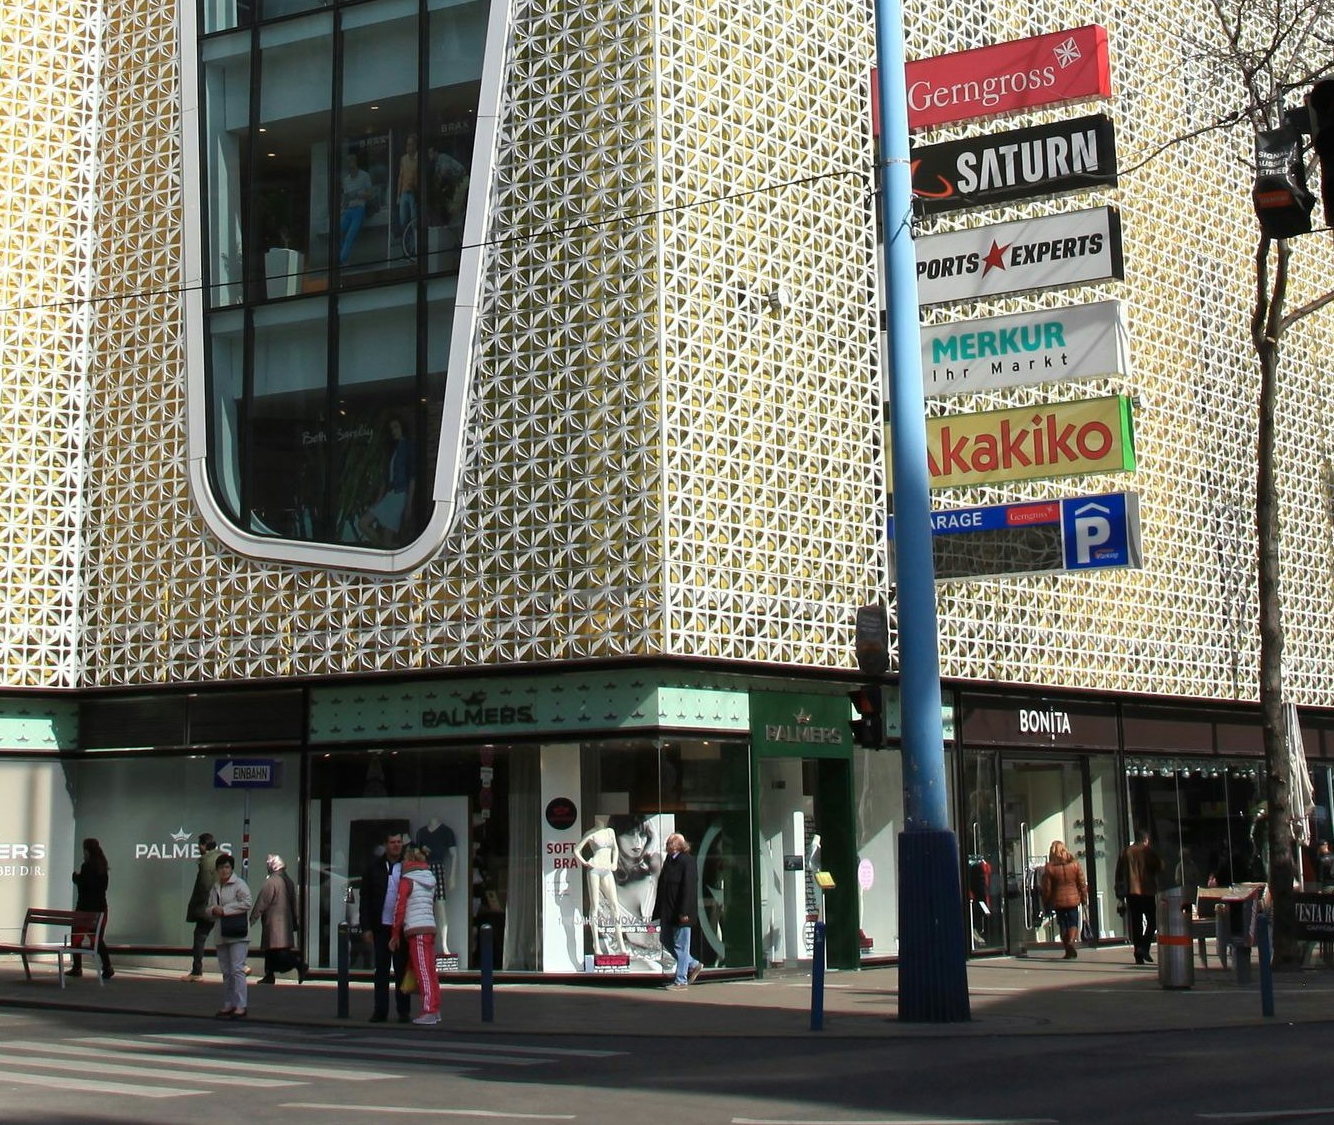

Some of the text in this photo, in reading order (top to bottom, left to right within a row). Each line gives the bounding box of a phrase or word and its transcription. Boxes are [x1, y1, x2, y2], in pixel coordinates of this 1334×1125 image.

[908, 66, 1056, 111] Gerngross
[956, 130, 1098, 194] SATURN
[917, 233, 1103, 281] PORTS EXPERTS
[932, 321, 1066, 364] MERKUR
[933, 352, 1068, 382] Ihr Markt
[930, 509, 1048, 530] RAGE Gerngross
[1074, 516, 1111, 564] P
[422, 705, 532, 729] PALMERS
[1020, 709, 1071, 740] BONITA
[766, 724, 843, 743] PALMERS
[233, 767, 267, 780] EINBAHN
[136, 842, 232, 859] PALMES
[547, 842, 576, 855] SOFT
[20, 866, 45, 876] DIR.
[554, 858, 578, 869] BRA
